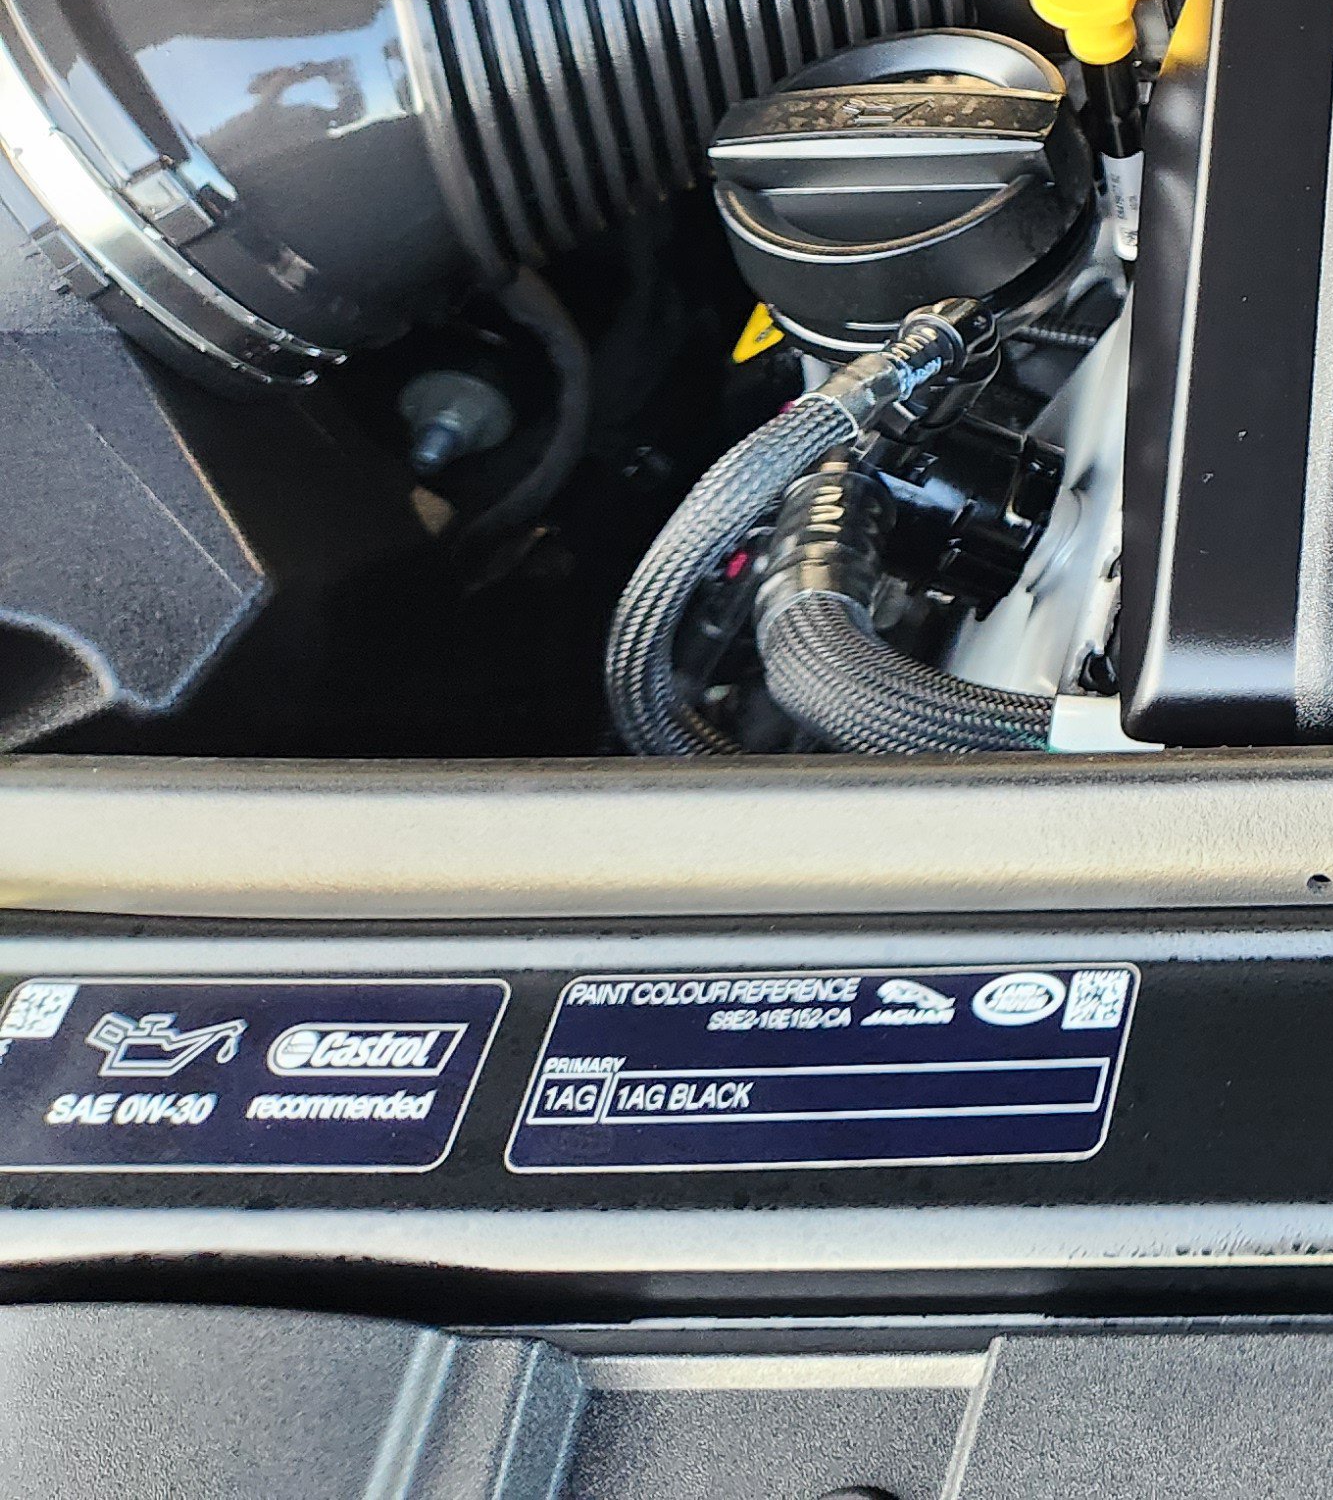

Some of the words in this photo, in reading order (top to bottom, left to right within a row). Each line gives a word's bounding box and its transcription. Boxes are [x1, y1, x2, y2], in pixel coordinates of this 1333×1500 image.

[566, 981, 633, 1006] PAINT
[633, 979, 731, 1005] COLOUR
[727, 977, 861, 1003] REFERENCE
[311, 1030, 434, 1068] Castrol
[542, 1056, 626, 1073] PRIMARY
[46, 1093, 120, 1124] SAE
[115, 1092, 218, 1124] 0W-30
[246, 1089, 437, 1121] recommended
[544, 1085, 598, 1111] 1AG
[616, 1084, 667, 1111] 1AG
[667, 1081, 755, 1110] BLACK
